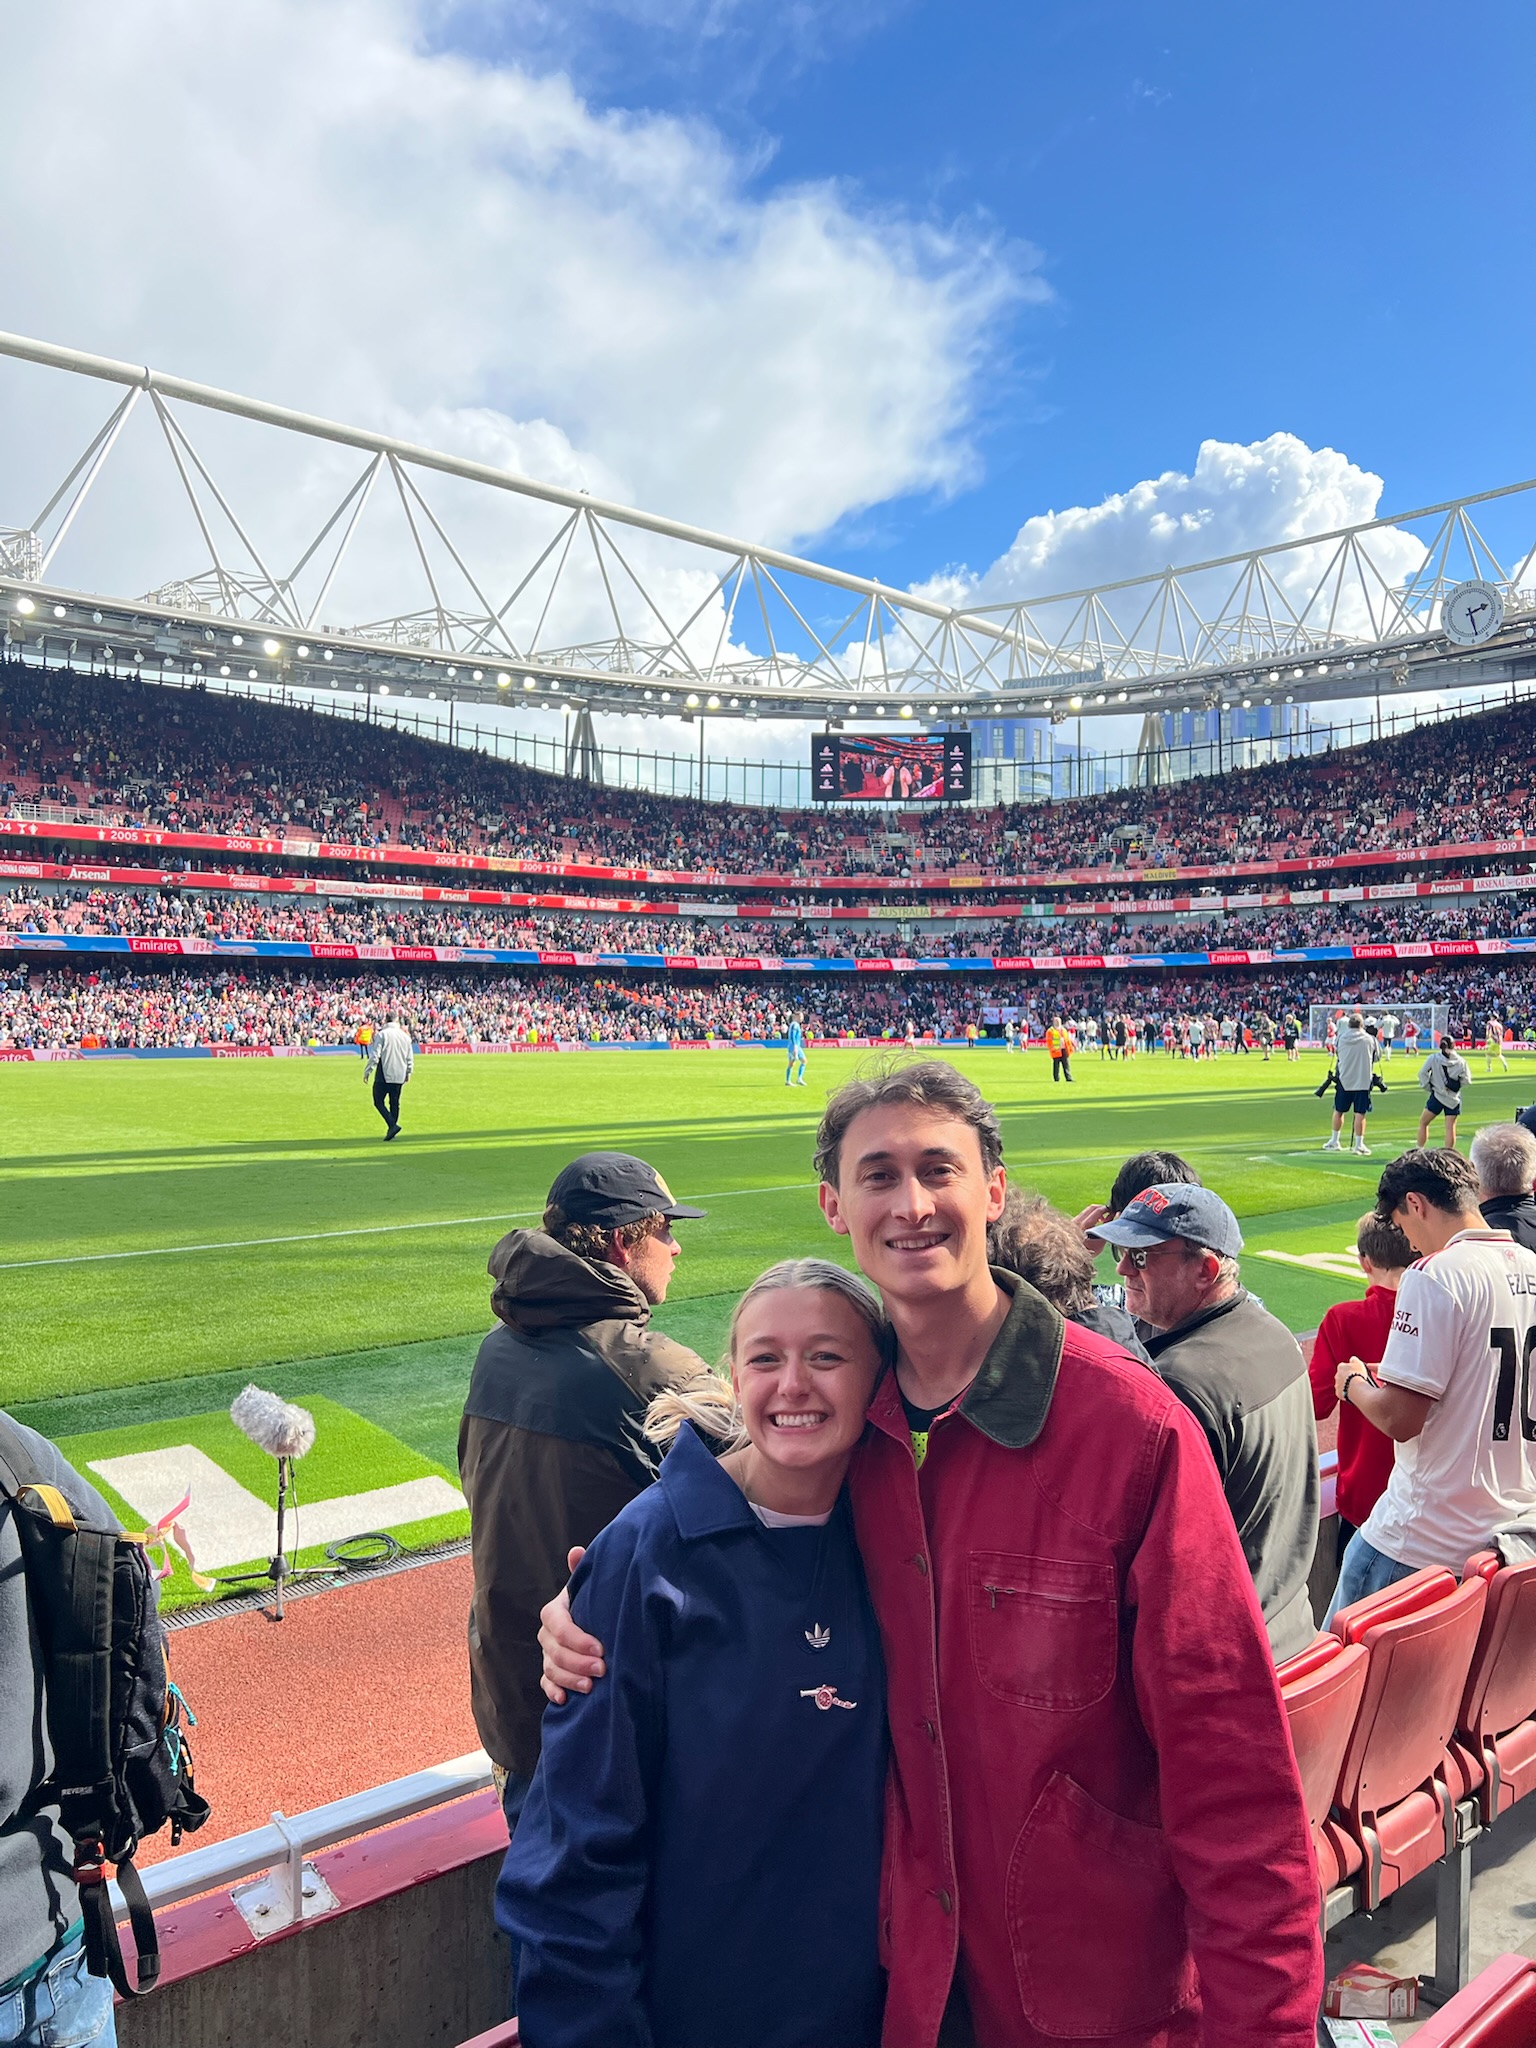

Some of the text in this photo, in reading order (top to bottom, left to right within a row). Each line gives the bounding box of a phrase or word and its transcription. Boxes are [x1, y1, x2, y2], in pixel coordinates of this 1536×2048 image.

[110, 831, 138, 841] 2005
[226, 840, 252, 849] 2006
[1495, 842, 1517, 851] 2019
[329, 848, 352, 856] 2007
[1396, 852, 1415, 861] 2018
[435, 856, 457, 865] 2008
[1316, 859, 1334, 868] 2017
[523, 862, 542, 871] 2009
[69, 868, 110, 880] Arsenal
[613, 870, 628, 878] 2010
[1208, 868, 1227, 876] 2016
[692, 875, 706, 883] 2011
[1477, 878, 1506, 888] ARSENAL
[353, 886, 384, 894] Arsenal
[394, 888, 422, 897] Liberia
[1430, 882, 1463, 893] Arsenal
[439, 890, 469, 901] Arsenal
[1066, 905, 1095, 914] Arsenal
[1113, 902, 1137, 912] HONG
[770, 908, 798, 917] Arsenal
[878, 907, 931, 917] AUSTRALIA
[132, 940, 178, 951] Emirates
[1434, 943, 1474, 953] Emirates
[314, 946, 354, 956] Emirates
[396, 949, 432, 958] Emirates
[1355, 946, 1392, 957] Emirates
[1408, 944, 1431, 954] BETTER
[541, 953, 573, 963] Emirates
[667, 957, 696, 967] Emirates
[1067, 958, 1101, 967] Emirates
[1211, 953, 1246, 963] Emirates
[728, 959, 759, 968] Emirates
[857, 959, 890, 969] Emirates
[996, 959, 1031, 968] Emirates
[673, 1042, 708, 1050] Emirates
[808, 1040, 837, 1048] Emirates
[216, 1049, 269, 1058] Emirates
[424, 1046, 469, 1054] Emirates
[1506, 1273, 1536, 1296] EZE
[1395, 1310, 1412, 1322] SIT
